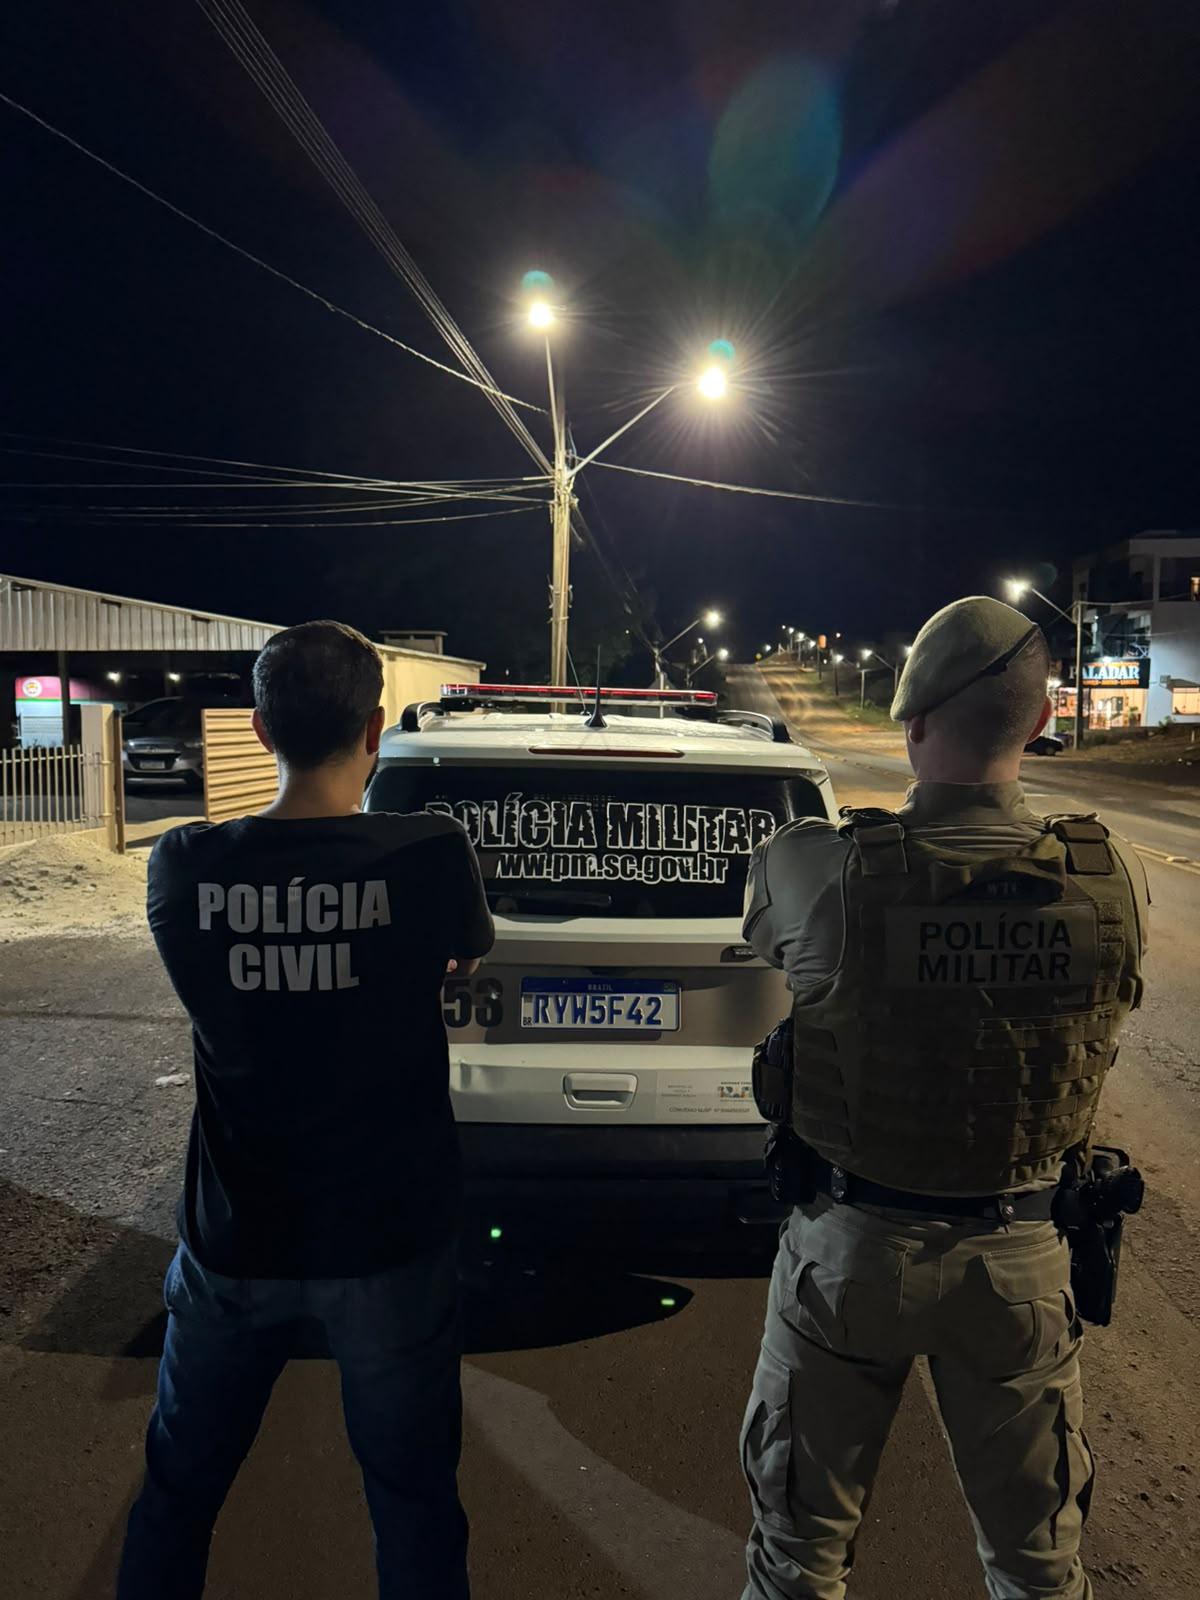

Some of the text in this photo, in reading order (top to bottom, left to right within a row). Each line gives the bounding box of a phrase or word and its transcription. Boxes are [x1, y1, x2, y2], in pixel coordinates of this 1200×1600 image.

[425, 792, 597, 848] OLÍCIA
[198, 877, 391, 933] POLÍCIA
[920, 912, 1072, 951] POLÍCIA
[229, 942, 360, 991] CIVIL
[918, 952, 1072, 984] MILITAR
[534, 994, 662, 1025] RYW5F42
